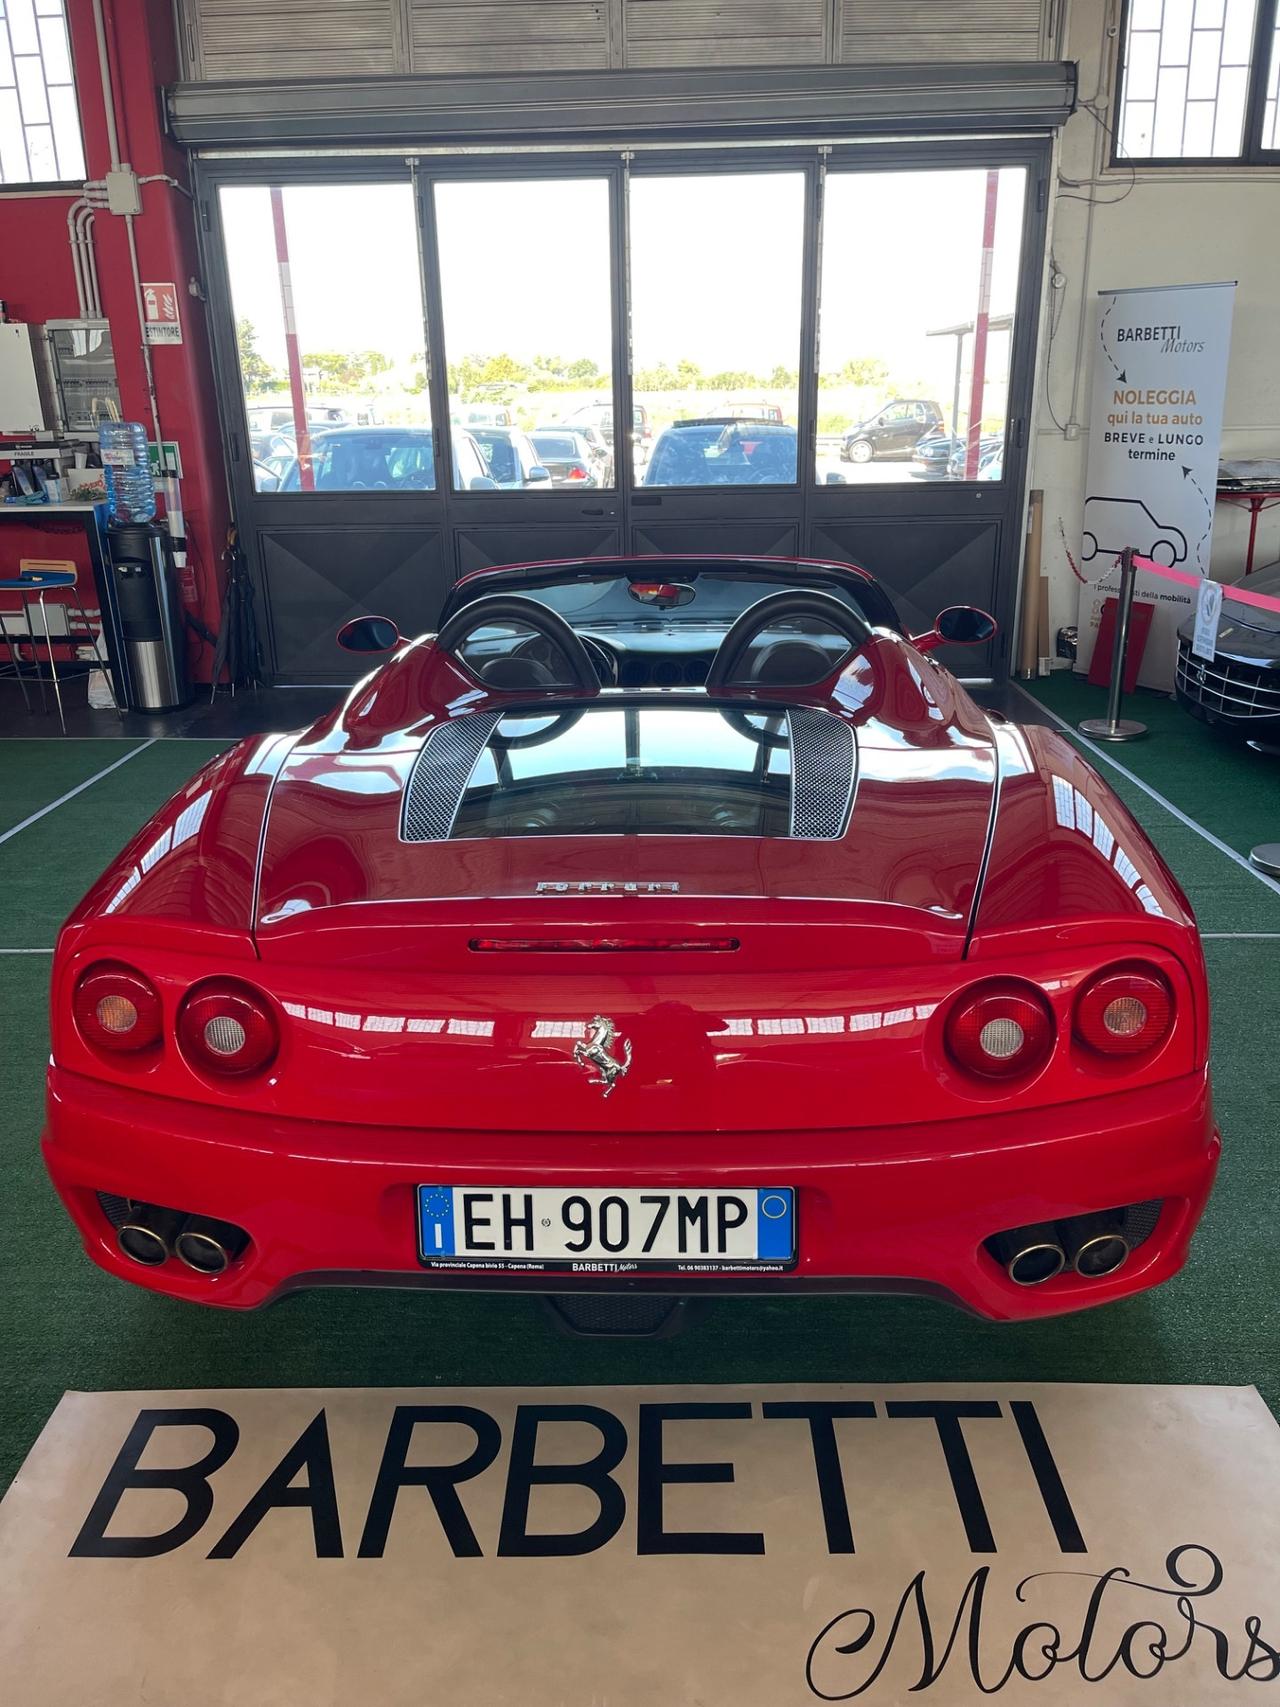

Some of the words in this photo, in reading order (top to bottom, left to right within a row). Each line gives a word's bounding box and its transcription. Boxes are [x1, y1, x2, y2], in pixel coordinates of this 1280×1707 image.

[145, 326, 179, 337] ESTINTORE
[1117, 325, 1181, 342] BARBETTI
[1160, 338, 1206, 353] Motors
[1113, 390, 1196, 405] NOLEGGIA
[1107, 410, 1128, 427] qui
[1131, 410, 1143, 424] la
[1146, 412, 1168, 425] tua
[1171, 412, 1203, 425] auto
[1104, 432, 1145, 443] BREVE
[1148, 436, 1154, 444] e
[1158, 433, 1204, 445] LUNGO
[1128, 448, 1176, 461] termine
[1141, 591, 1159, 600] della
[1160, 593, 1192, 604] mobilità
[463, 1193, 534, 1251] EH
[561, 1195, 748, 1253] 907MP
[439, 1261, 466, 1269] provinciale
[466, 1261, 485, 1269] Capena
[572, 1263, 618, 1272] BARBETTI
[68, 1401, 1088, 1559] BARBETTI
[806, 1544, 1280, 1701] Motors
